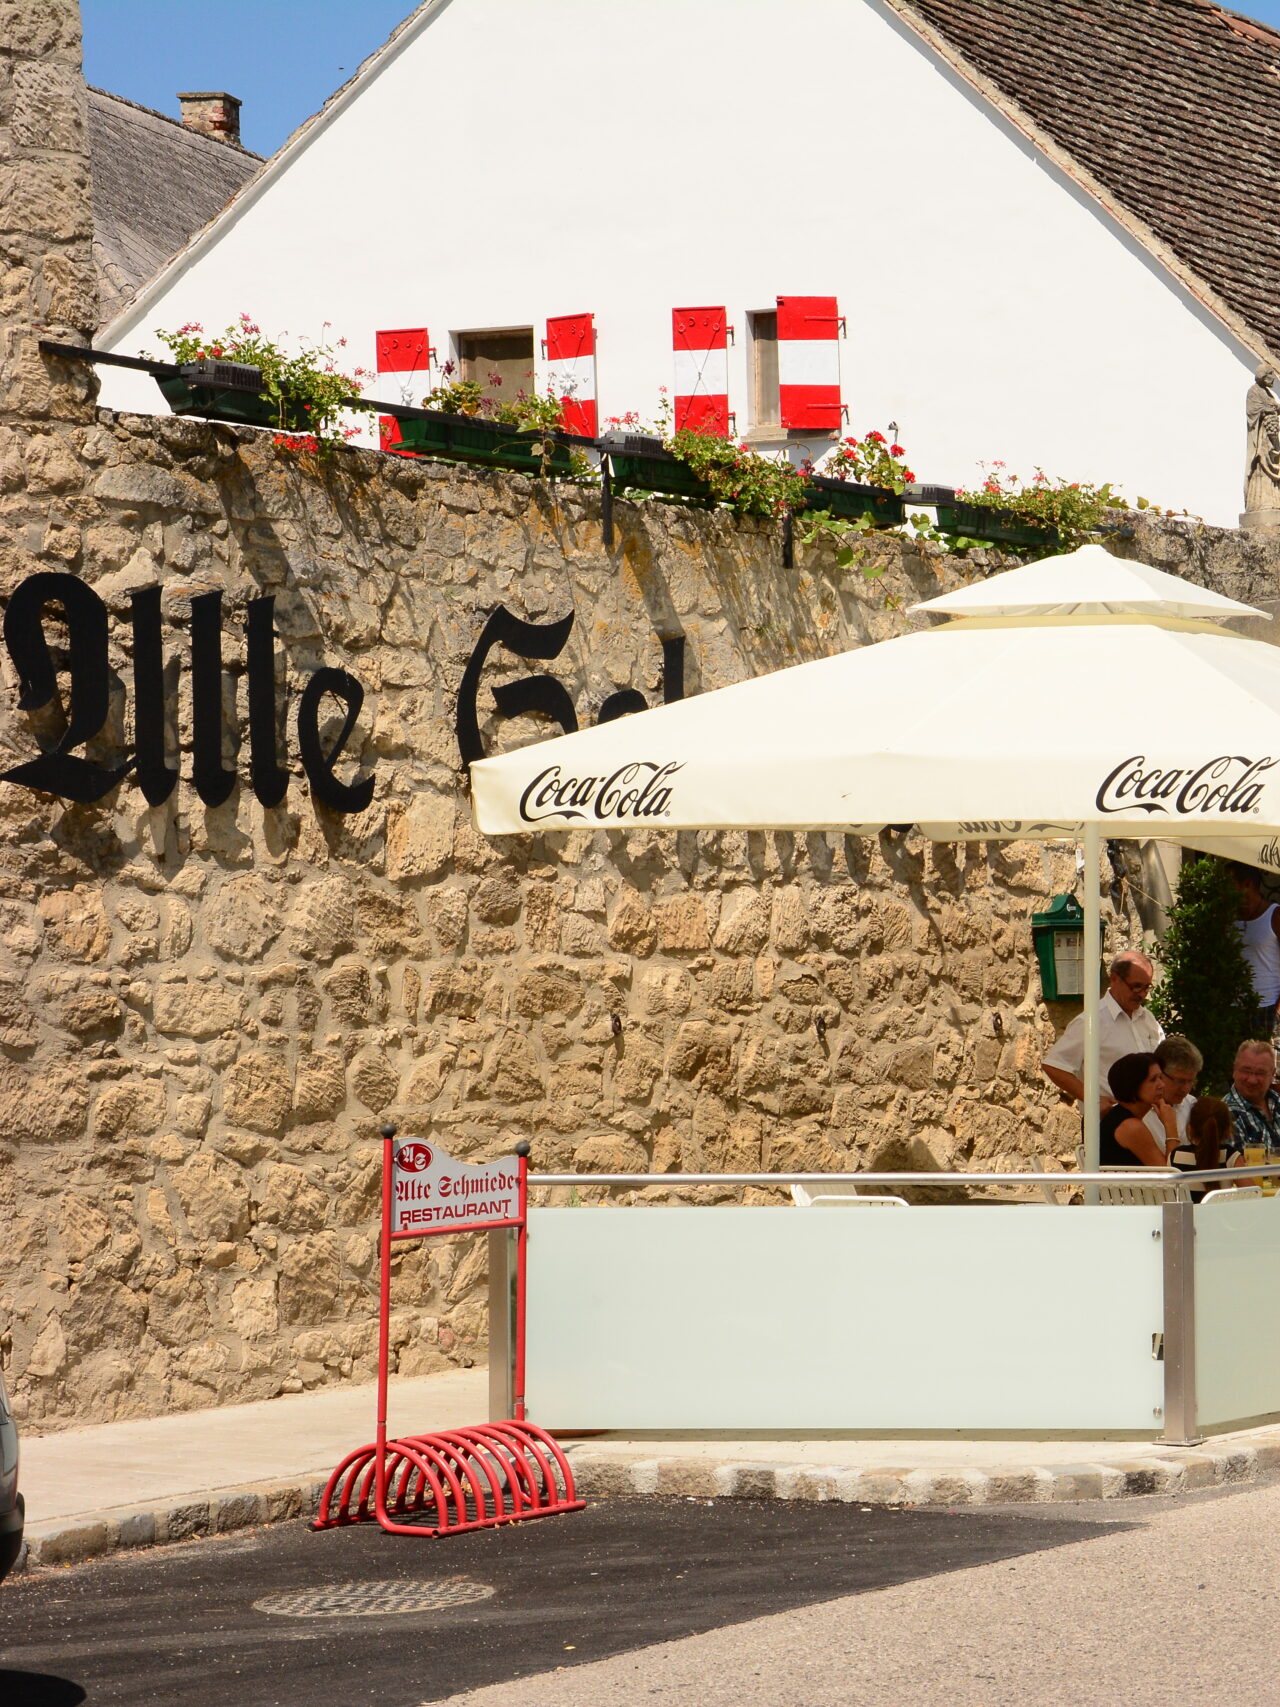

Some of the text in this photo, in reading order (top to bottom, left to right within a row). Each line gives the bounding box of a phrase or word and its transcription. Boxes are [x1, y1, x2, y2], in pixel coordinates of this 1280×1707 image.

[520, 761, 687, 822] Coca-Cola
[396, 1170, 515, 1202] Alte Schmiede
[400, 1199, 511, 1225] RESTAURANT
